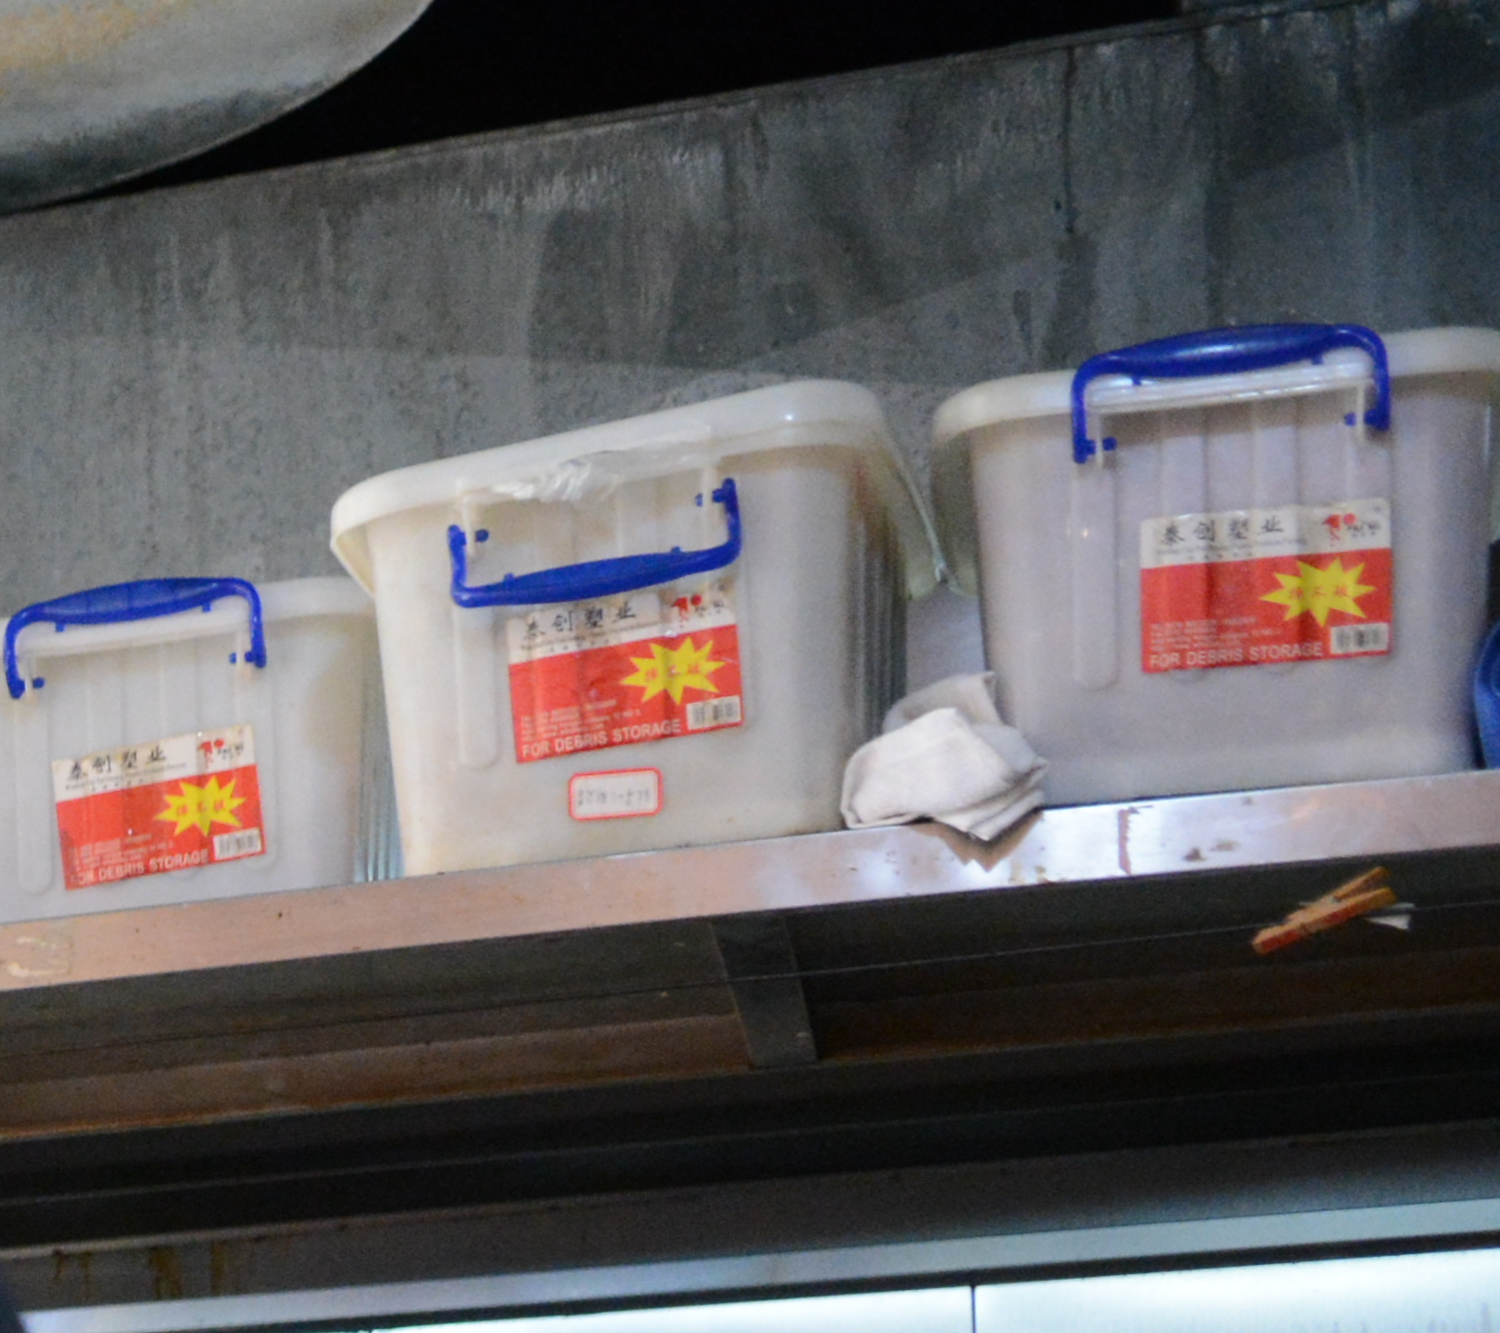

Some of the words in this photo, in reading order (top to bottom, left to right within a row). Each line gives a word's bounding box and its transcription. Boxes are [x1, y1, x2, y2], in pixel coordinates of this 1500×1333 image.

[1151, 652, 1181, 668] FOR
[1186, 648, 1243, 666] DEBRIS
[1250, 641, 1323, 661] STORAGE
[522, 741, 551, 757] FOR
[555, 731, 608, 753] DEBRIS
[613, 718, 681, 743] STORAGE
[98, 861, 145, 881] DEBRIS
[149, 848, 209, 871] STORAGE
